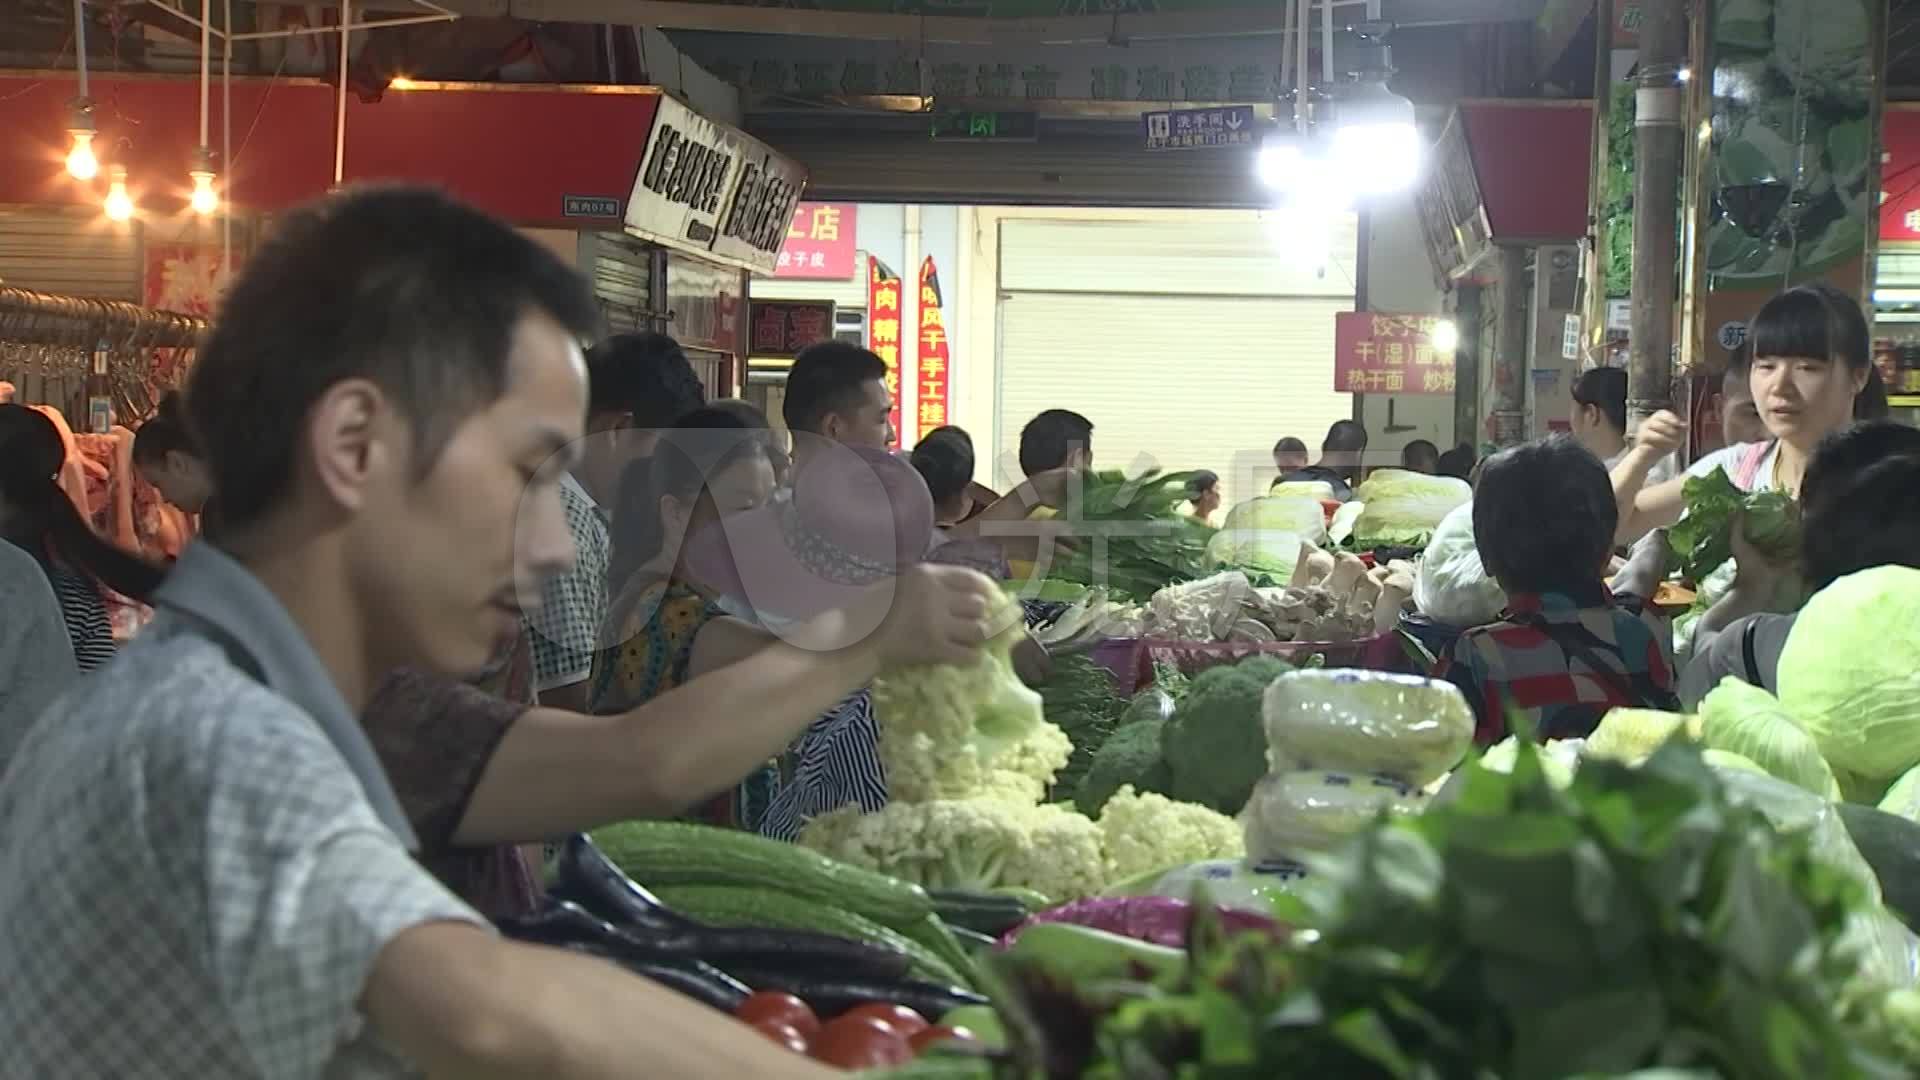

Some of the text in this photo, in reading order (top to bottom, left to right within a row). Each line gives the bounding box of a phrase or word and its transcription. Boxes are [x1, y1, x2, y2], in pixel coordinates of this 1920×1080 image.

[1177, 112, 1223, 128] 洗手间
[1723, 326, 1746, 346] 新
[1346, 369, 1405, 391] 热干面
